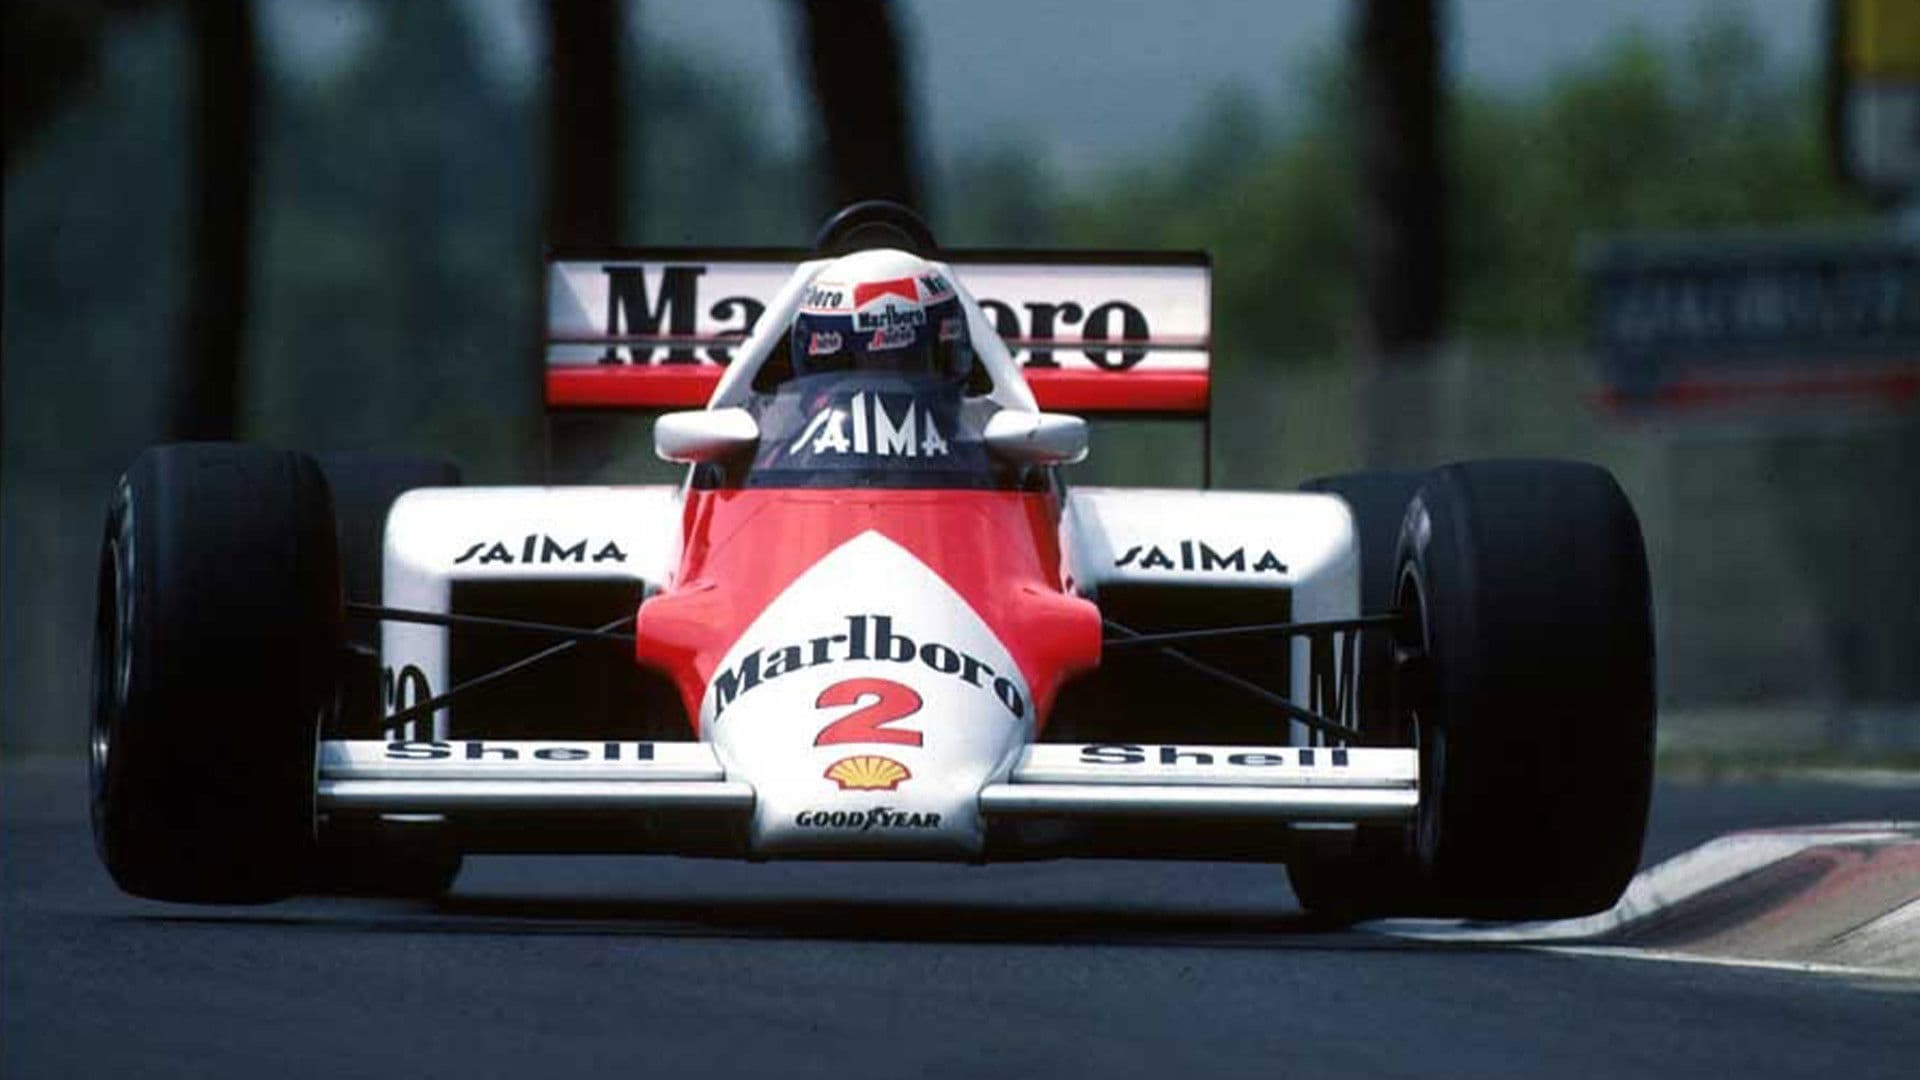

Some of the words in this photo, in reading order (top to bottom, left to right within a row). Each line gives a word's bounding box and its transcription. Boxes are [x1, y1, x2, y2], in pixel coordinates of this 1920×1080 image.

[598, 265, 1151, 373] Maoro
[789, 391, 949, 457] SAIMA
[454, 534, 628, 565] SAIMA
[1114, 540, 1289, 574] SAIMA
[713, 614, 1025, 723] Marlboro
[813, 677, 924, 748] 2
[385, 740, 655, 761] Shell
[1079, 743, 1350, 767] Shell
